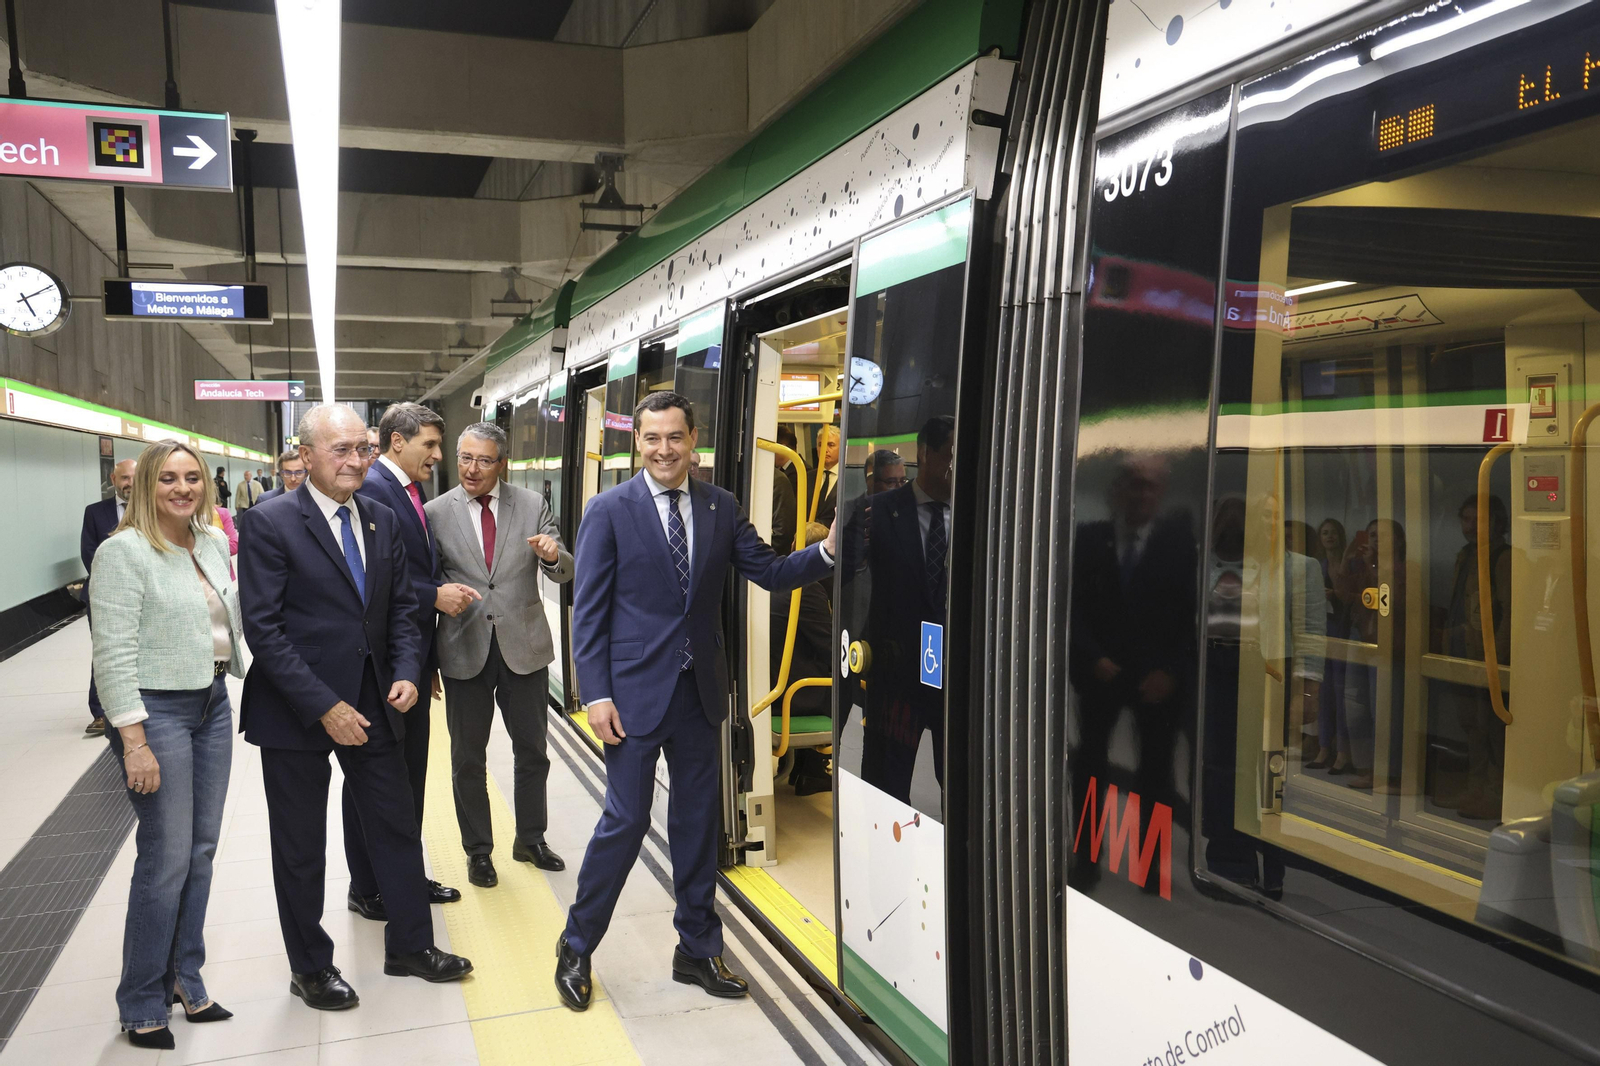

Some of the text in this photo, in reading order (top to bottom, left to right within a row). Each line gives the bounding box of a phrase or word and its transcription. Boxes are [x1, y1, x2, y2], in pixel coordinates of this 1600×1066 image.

[1104, 146, 1173, 202] 3073
[155, 292, 229, 304] Bienvenidos a
[147, 304, 235, 318] Metro de Málaga
[200, 388, 265, 398] Andalucía Tech
[1166, 1004, 1245, 1066] de Control
